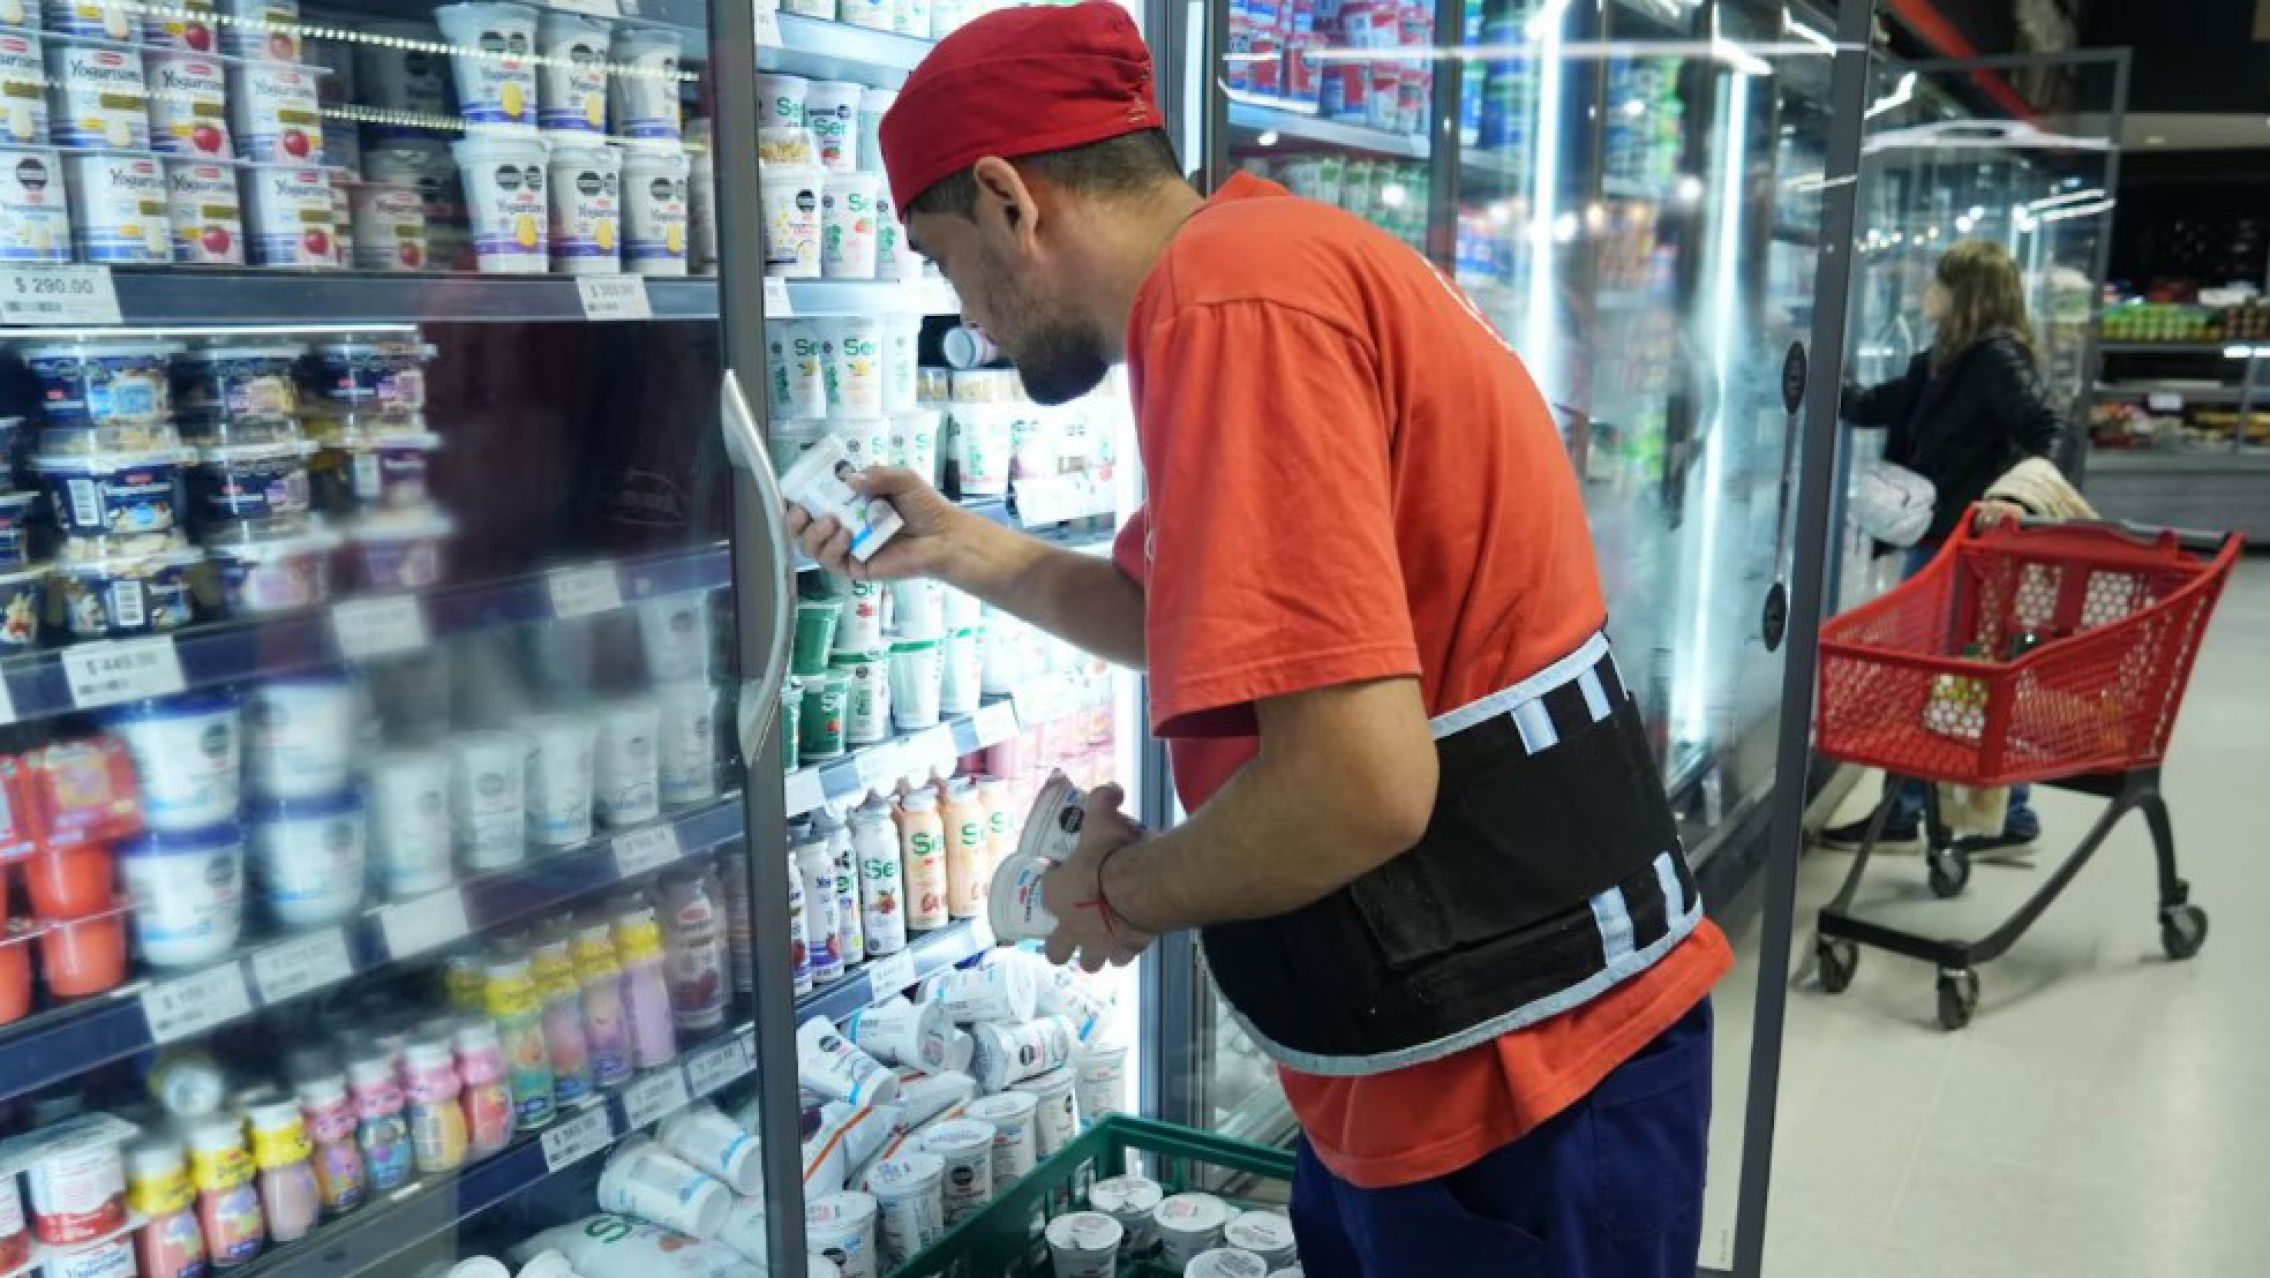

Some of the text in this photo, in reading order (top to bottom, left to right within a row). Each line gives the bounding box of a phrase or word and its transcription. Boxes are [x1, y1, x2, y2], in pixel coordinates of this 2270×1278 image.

[14, 276, 27, 294] $
[911, 832, 944, 857] Se
[864, 858, 895, 879] Se
